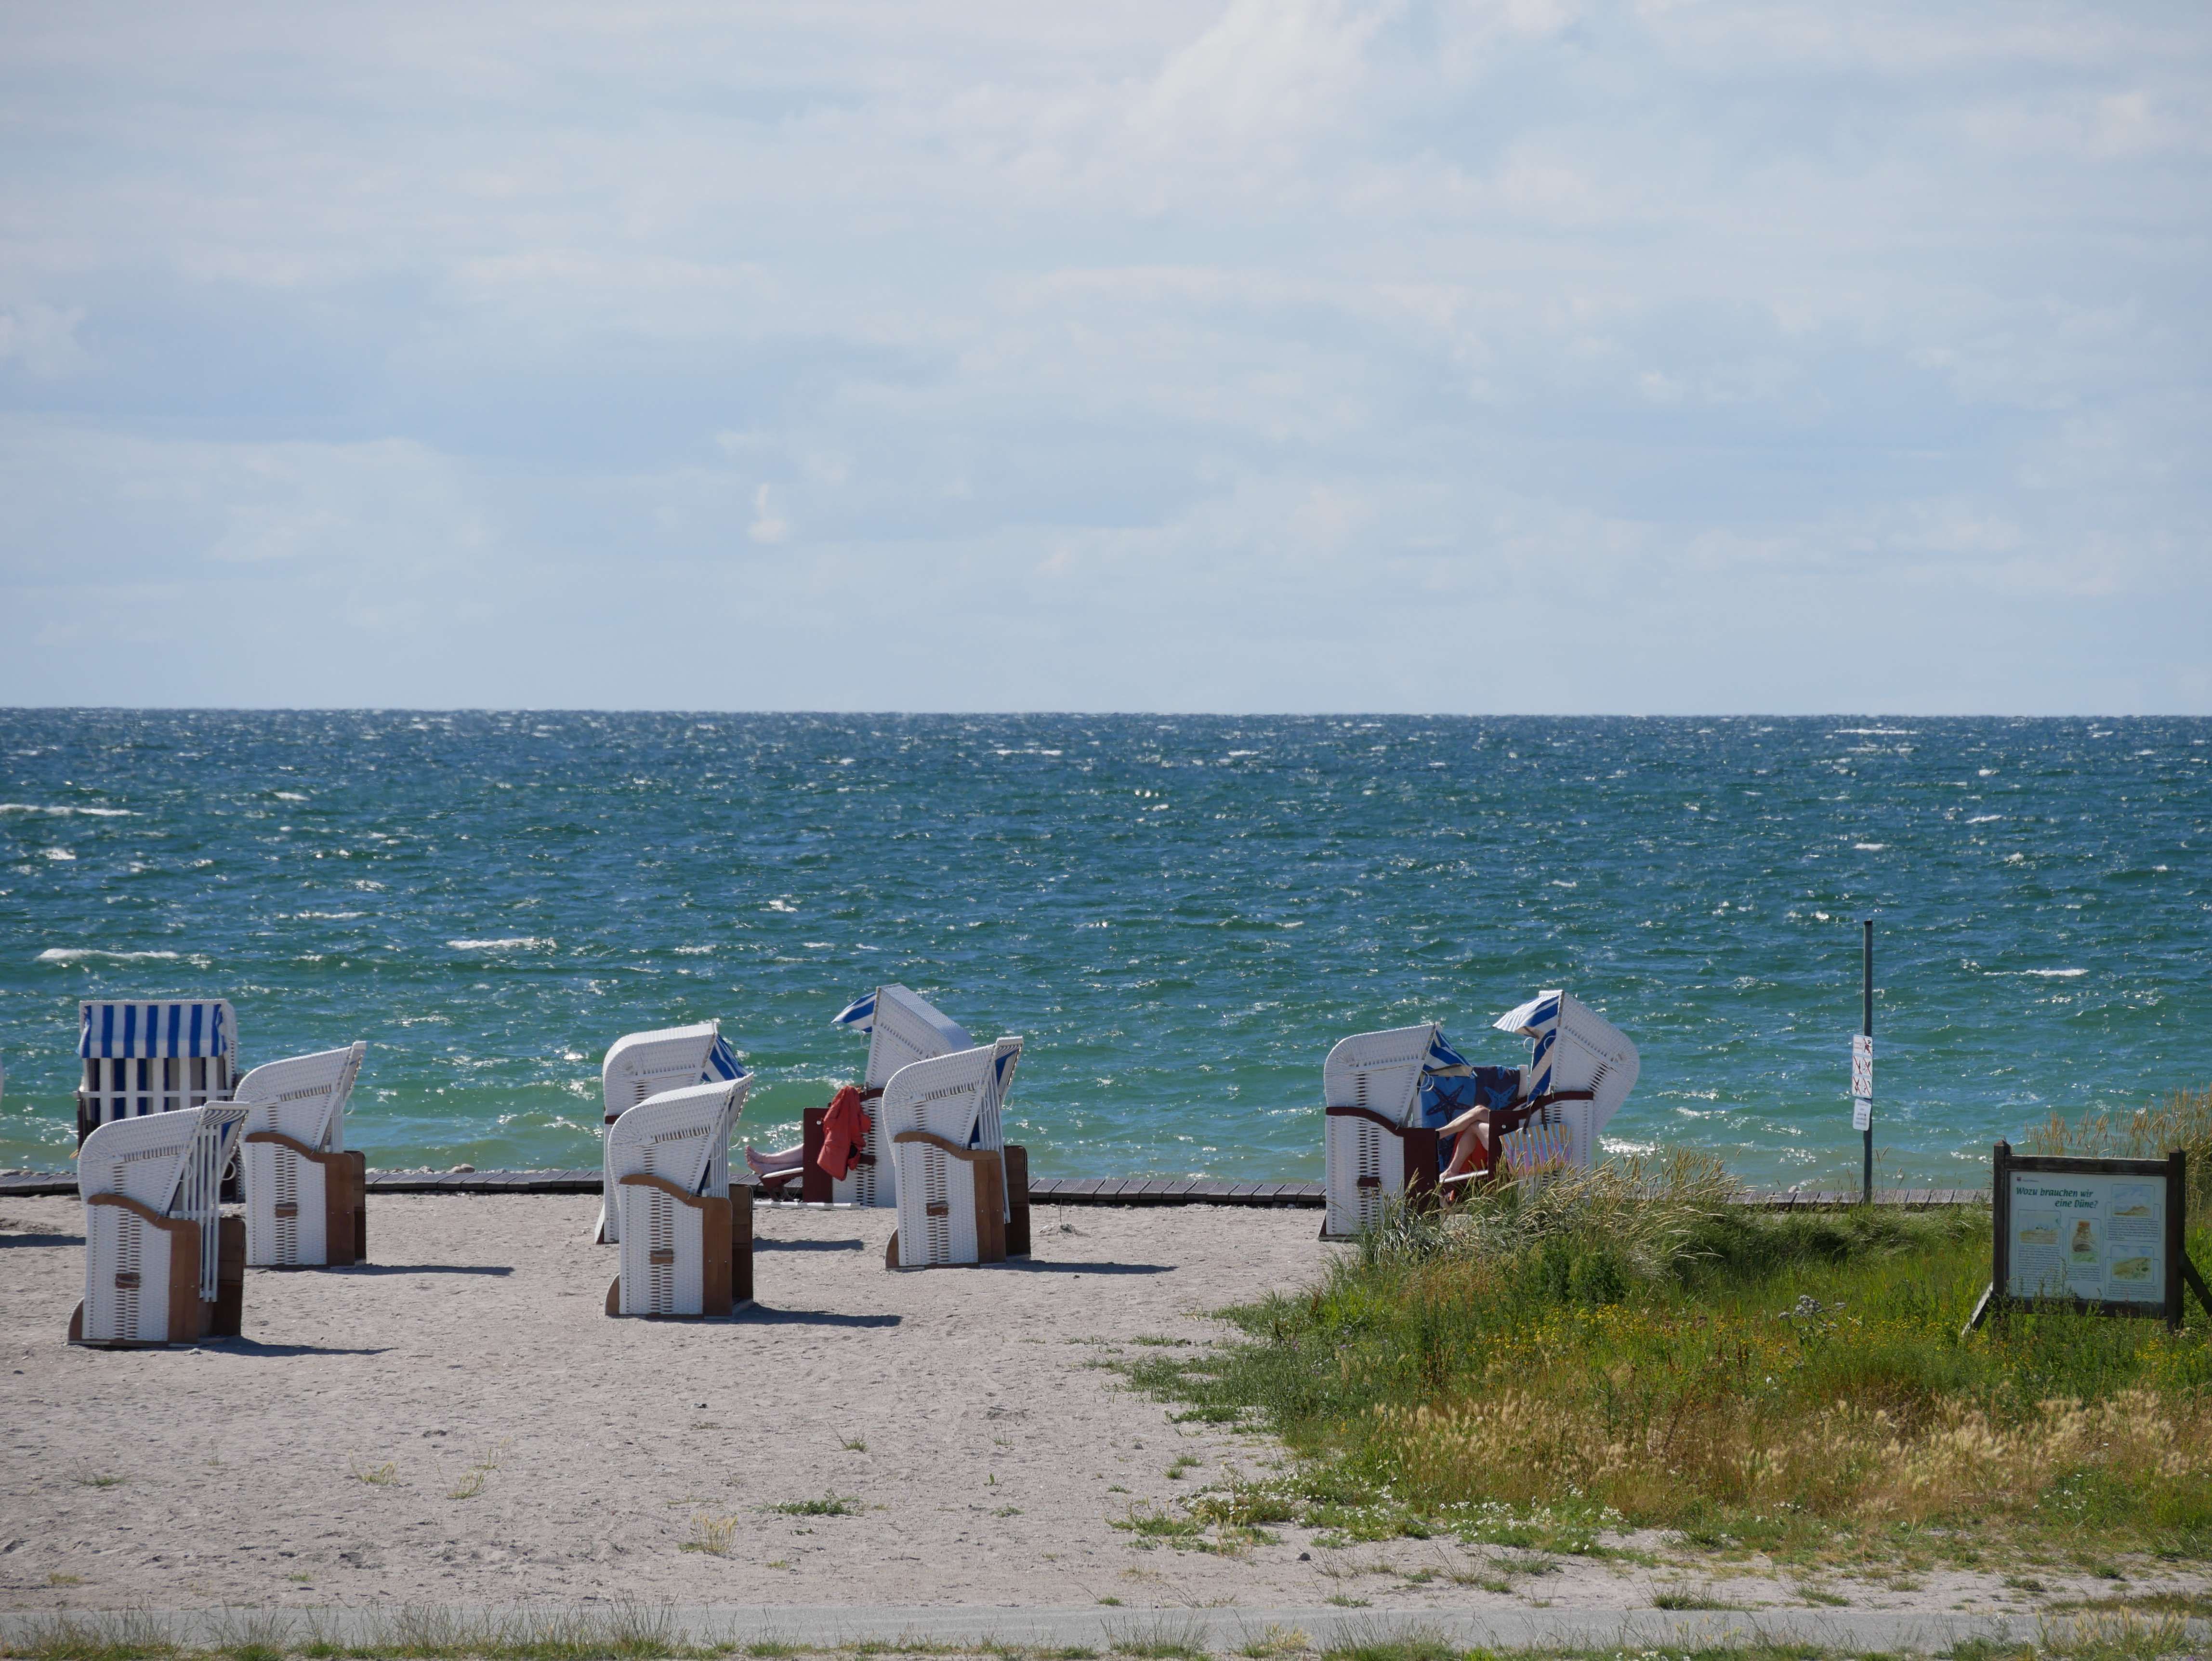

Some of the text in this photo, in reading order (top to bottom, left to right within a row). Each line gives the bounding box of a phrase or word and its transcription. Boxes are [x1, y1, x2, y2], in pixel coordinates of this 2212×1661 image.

[2016, 1187, 2094, 1198] Wozu brauchen wir
[2054, 1199, 2098, 1208] eine Düne?
